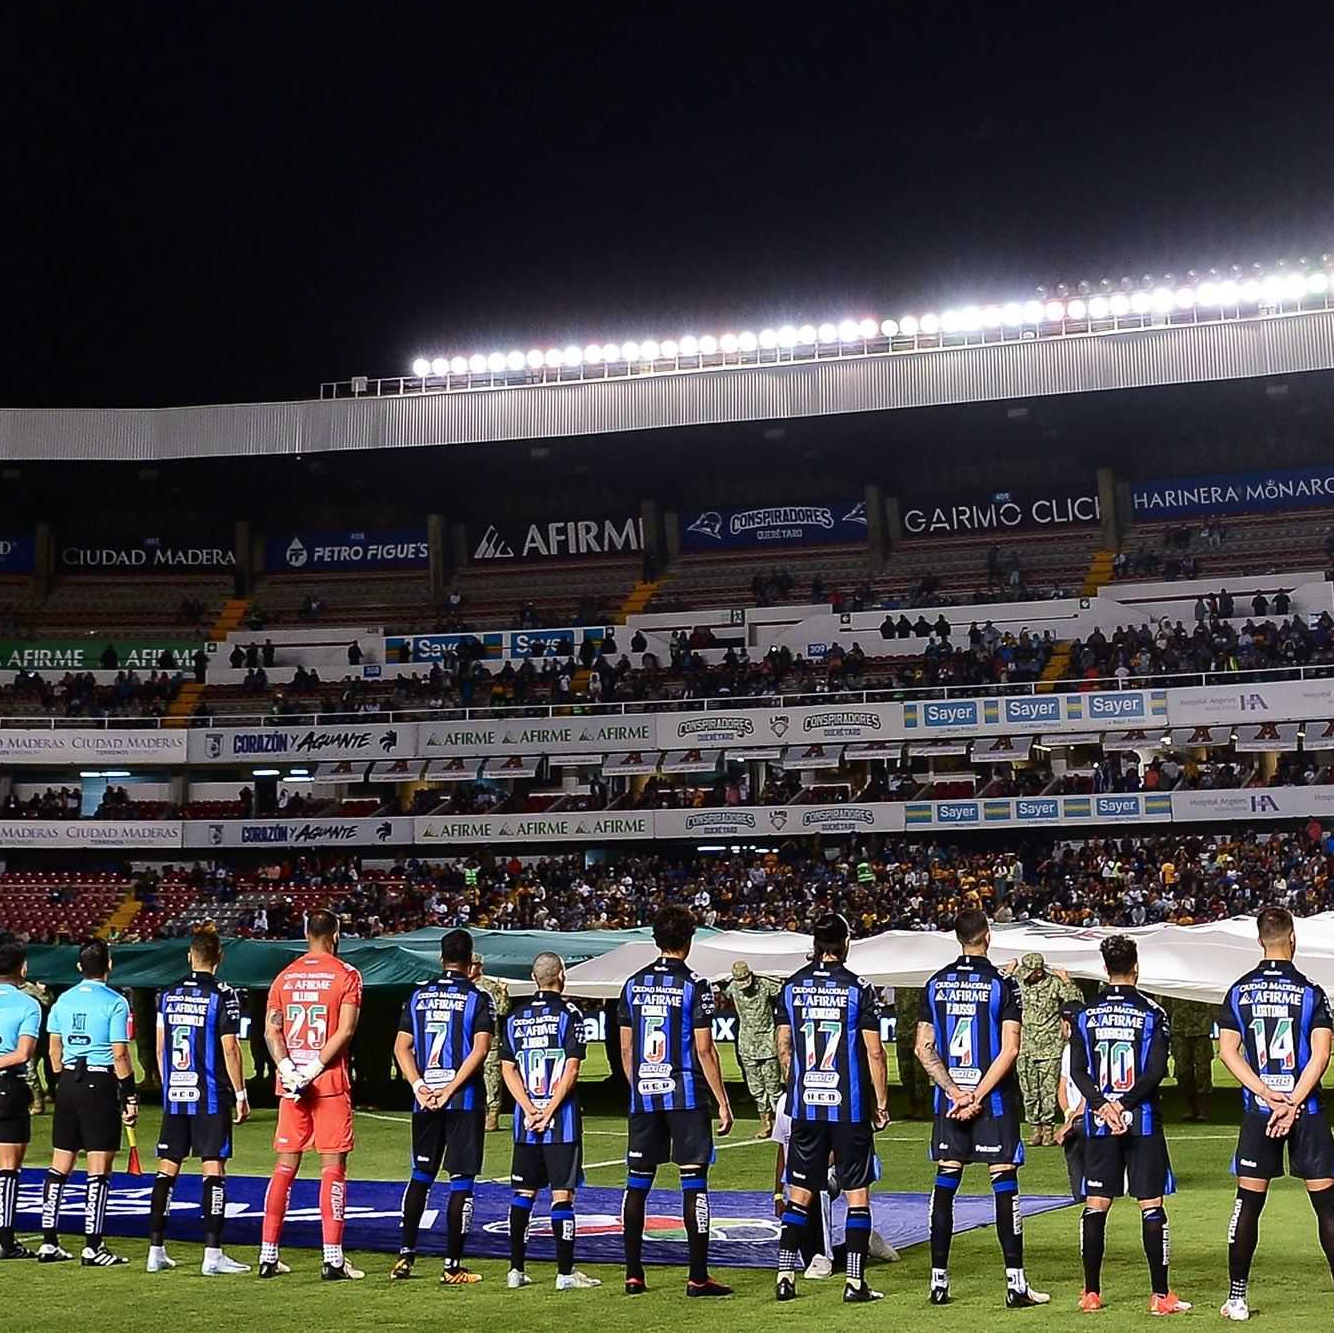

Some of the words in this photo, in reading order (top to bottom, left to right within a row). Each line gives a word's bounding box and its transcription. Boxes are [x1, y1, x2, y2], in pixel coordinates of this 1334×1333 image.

[1134, 488, 1239, 510] HARINERA
[730, 507, 834, 532] CONSPIRADORES
[62, 547, 146, 566] CIUDAD
[313, 547, 362, 561] PETRO
[8, 650, 83, 666] AFIRME
[928, 705, 973, 723] Sayer
[1010, 701, 1055, 720] Sayer
[1093, 696, 1139, 715] Sayer
[677, 718, 754, 737] CONSPIRADORES
[803, 712, 882, 731] CONSPIRADORES
[7, 738, 65, 748] MADERAS
[72, 737, 122, 749] CIUDAD
[126, 737, 184, 748] MADERAS
[233, 731, 287, 754] CORAZÓN
[297, 732, 372, 751] AGUANTE
[444, 731, 495, 746] AFIRME
[520, 729, 571, 743] AFIRME
[597, 726, 649, 741] AFIRME
[685, 812, 756, 829] CONSPIRADORES
[803, 809, 874, 826] CONSPIRADORES
[940, 805, 974, 820] Sayer
[1019, 802, 1055, 817] Sayer
[1100, 798, 1136, 815] Sayer
[2, 827, 59, 838] MADERAS
[67, 826, 117, 838] CIUDAD
[121, 827, 179, 838] MADERAS
[242, 823, 288, 842] CORAZÓN
[295, 824, 358, 841] AGUANTE
[441, 823, 491, 838] AFIRME
[517, 820, 568, 835] AFIRME
[593, 819, 645, 834] AFIRME
[947, 990, 989, 1002] AFIRME
[1239, 982, 1267, 993] CIUDAD
[1254, 991, 1302, 1005] AFIRME
[429, 999, 465, 1011] AFIRME
[644, 995, 682, 1007] AFIRME
[807, 996, 847, 1008] AFIRME
[1086, 1007, 1112, 1016] CIUDAD
[286, 1004, 327, 1049] 25
[1101, 1017, 1143, 1029] AFIRME
[172, 1026, 190, 1070] 5
[425, 1023, 447, 1068] 7
[643, 1017, 667, 1063] 6
[800, 1021, 842, 1071] 17
[950, 1017, 973, 1067] 4
[1249, 1018, 1296, 1070] 14
[1094, 1042, 1136, 1093] 10
[332, 1180, 344, 1221] PERDURA
[696, 1192, 708, 1234] PERDURA
[1226, 1198, 1243, 1244] PERDURA
